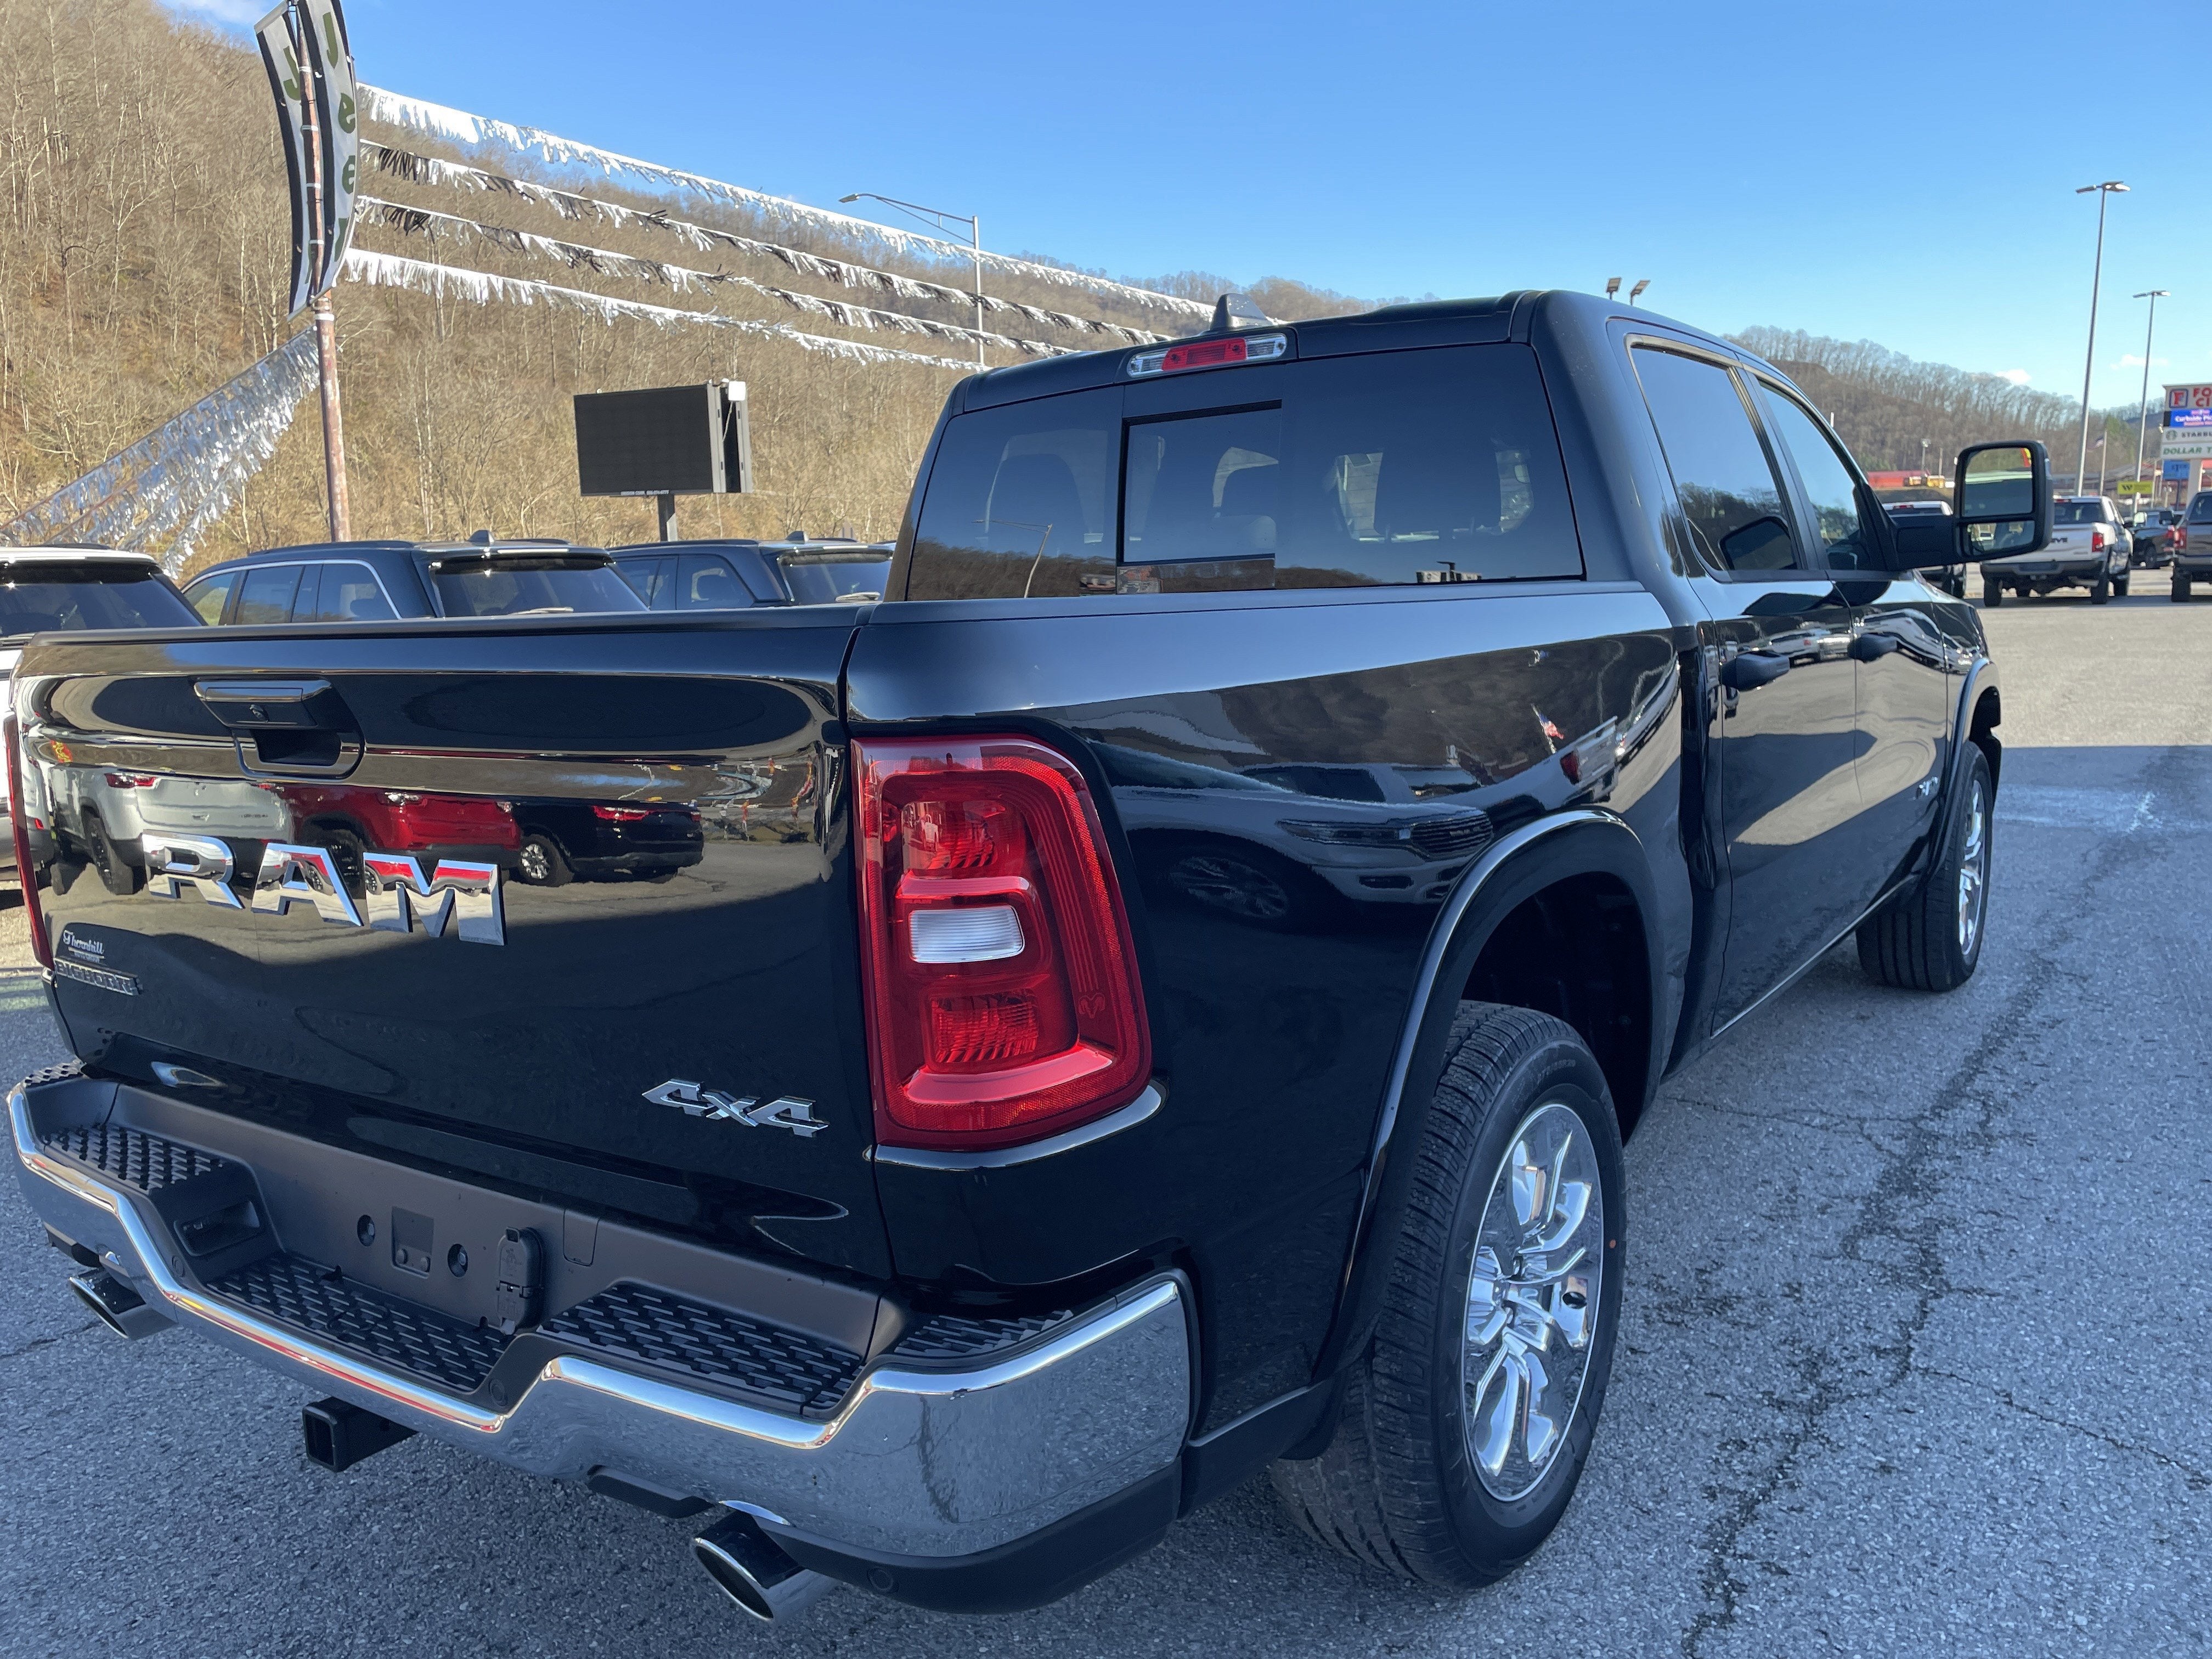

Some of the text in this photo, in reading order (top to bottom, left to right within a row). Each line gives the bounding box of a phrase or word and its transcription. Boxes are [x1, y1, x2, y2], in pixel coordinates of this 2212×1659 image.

[2163, 447, 2202, 455] DOLLAR
[142, 830, 505, 946] RAM
[63, 929, 104, 955] Thornhill
